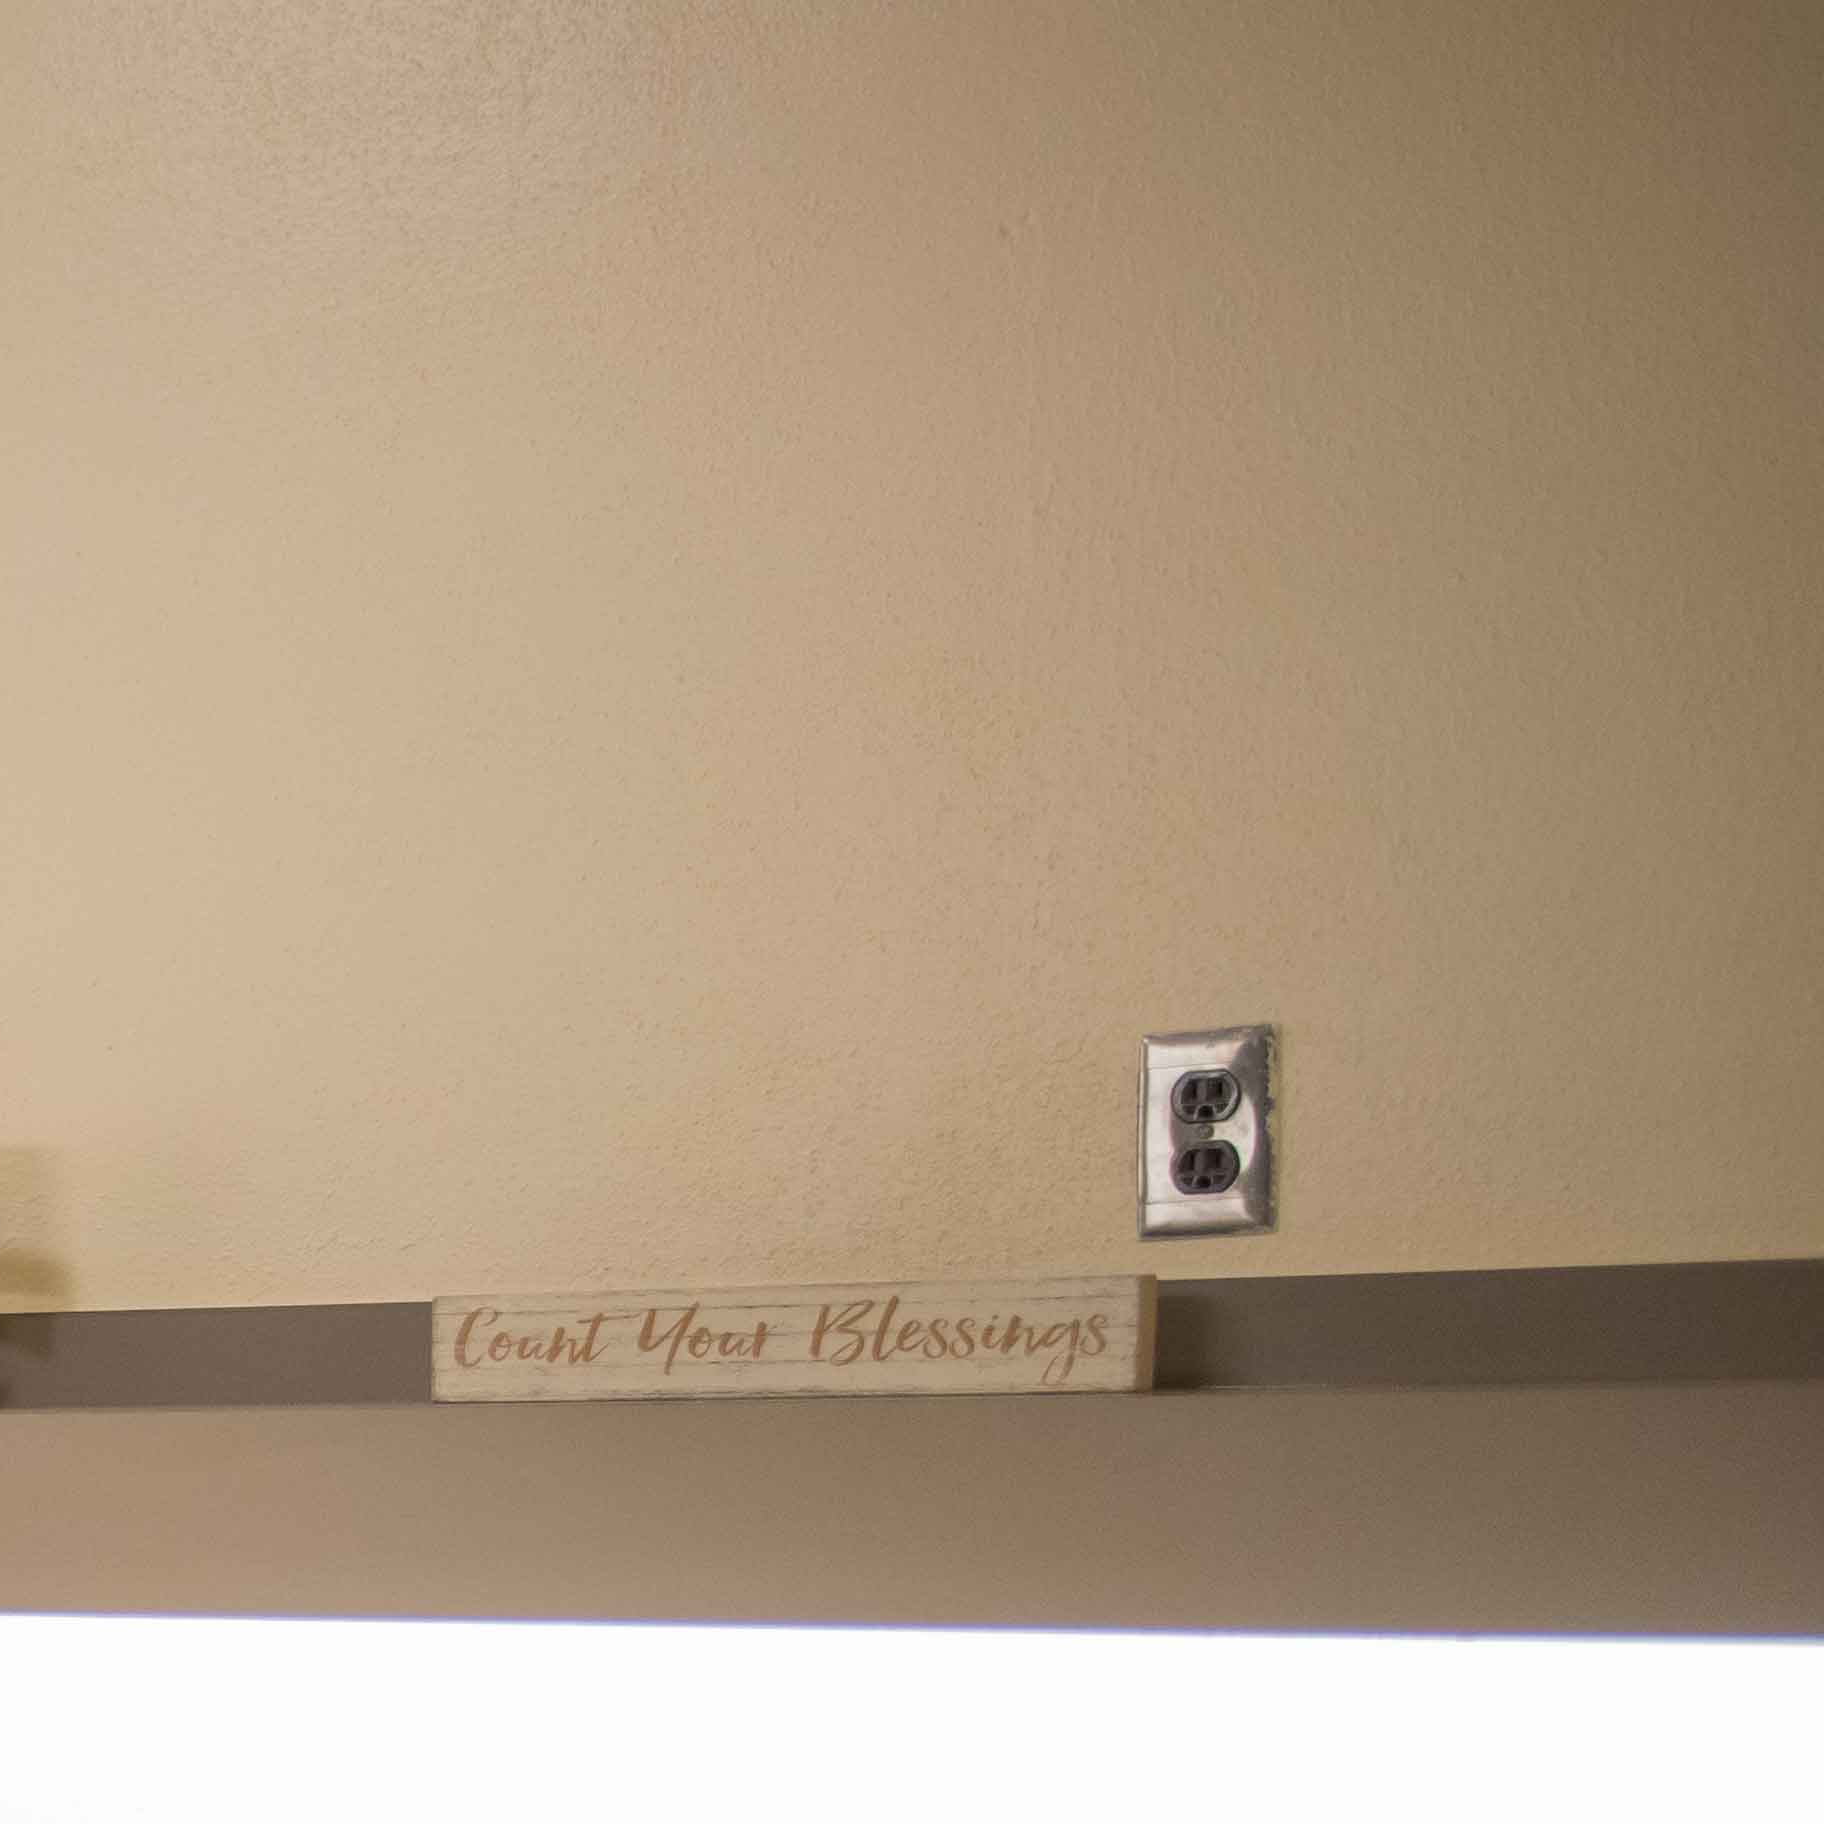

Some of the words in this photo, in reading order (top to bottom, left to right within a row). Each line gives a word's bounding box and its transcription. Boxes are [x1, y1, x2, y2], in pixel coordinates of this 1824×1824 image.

[453, 1306, 638, 1367] Count
[636, 1300, 773, 1375] Your
[809, 1295, 1110, 1387] Blessings
